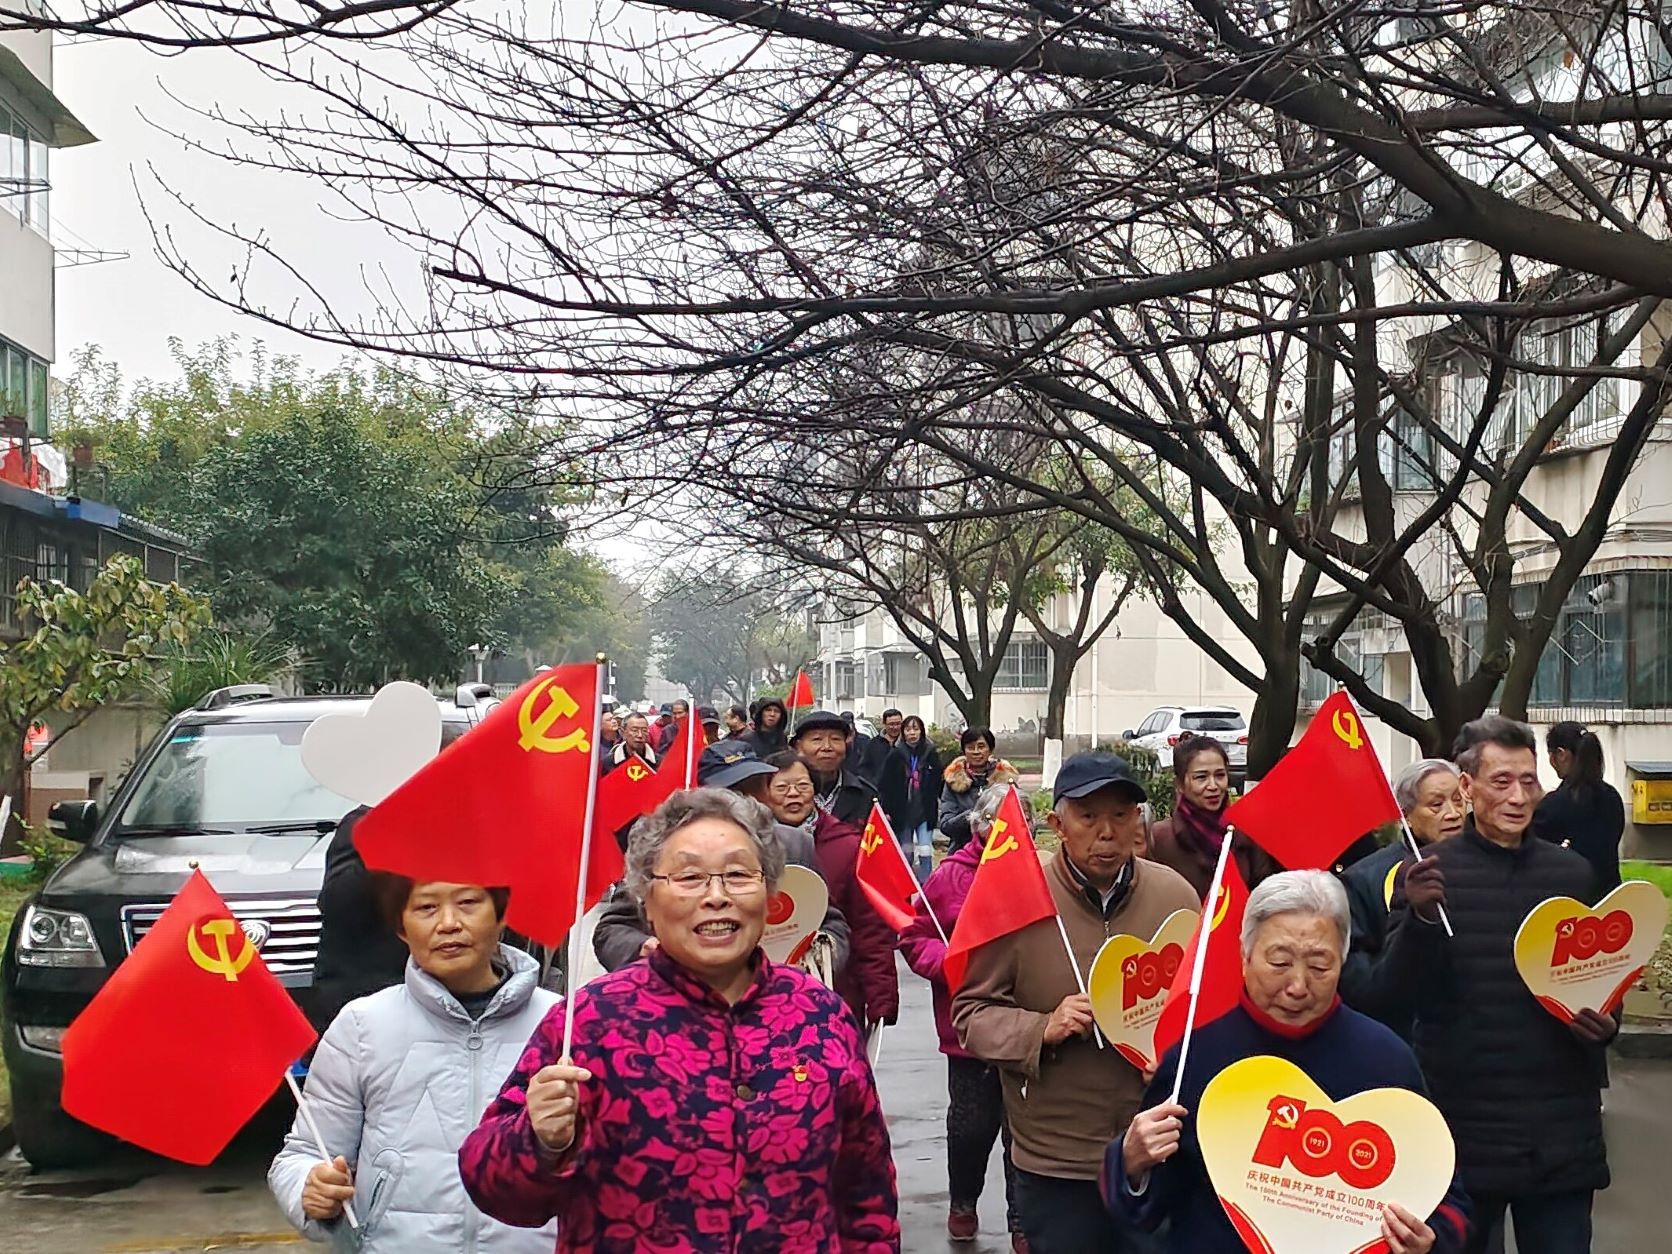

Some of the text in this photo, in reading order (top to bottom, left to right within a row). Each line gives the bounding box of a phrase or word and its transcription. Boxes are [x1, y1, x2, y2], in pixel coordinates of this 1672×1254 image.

[1551, 910, 1633, 967] 100
[1251, 1094, 1396, 1189] 100
[1310, 1137, 1325, 1148] 1921
[1355, 1148, 1372, 1159] 2021
[1246, 1182, 1258, 1190] The
[1342, 1206, 1374, 1221] Founding
[1247, 1170, 1386, 1211] 庆祝中国共产党成立100周年
[1263, 1195, 1275, 1203] The
[1317, 1208, 1334, 1219] Party
[1344, 1215, 1364, 1226] China
